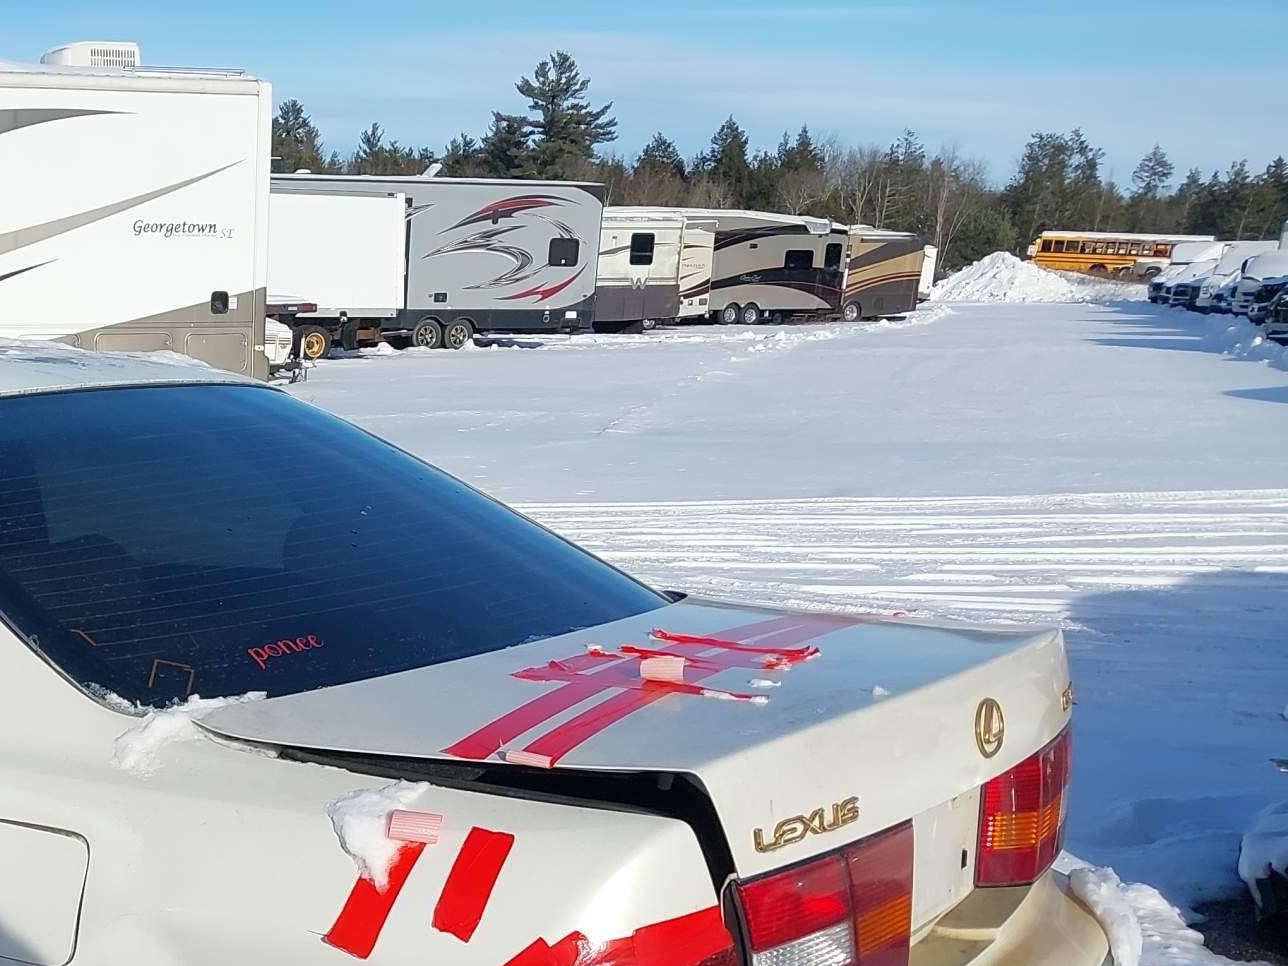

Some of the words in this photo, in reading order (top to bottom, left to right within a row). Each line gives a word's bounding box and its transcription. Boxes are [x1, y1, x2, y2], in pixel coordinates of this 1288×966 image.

[132, 219, 217, 238] Georgetown
[247, 634, 324, 670] ponce
[753, 796, 859, 853] LEXUS
